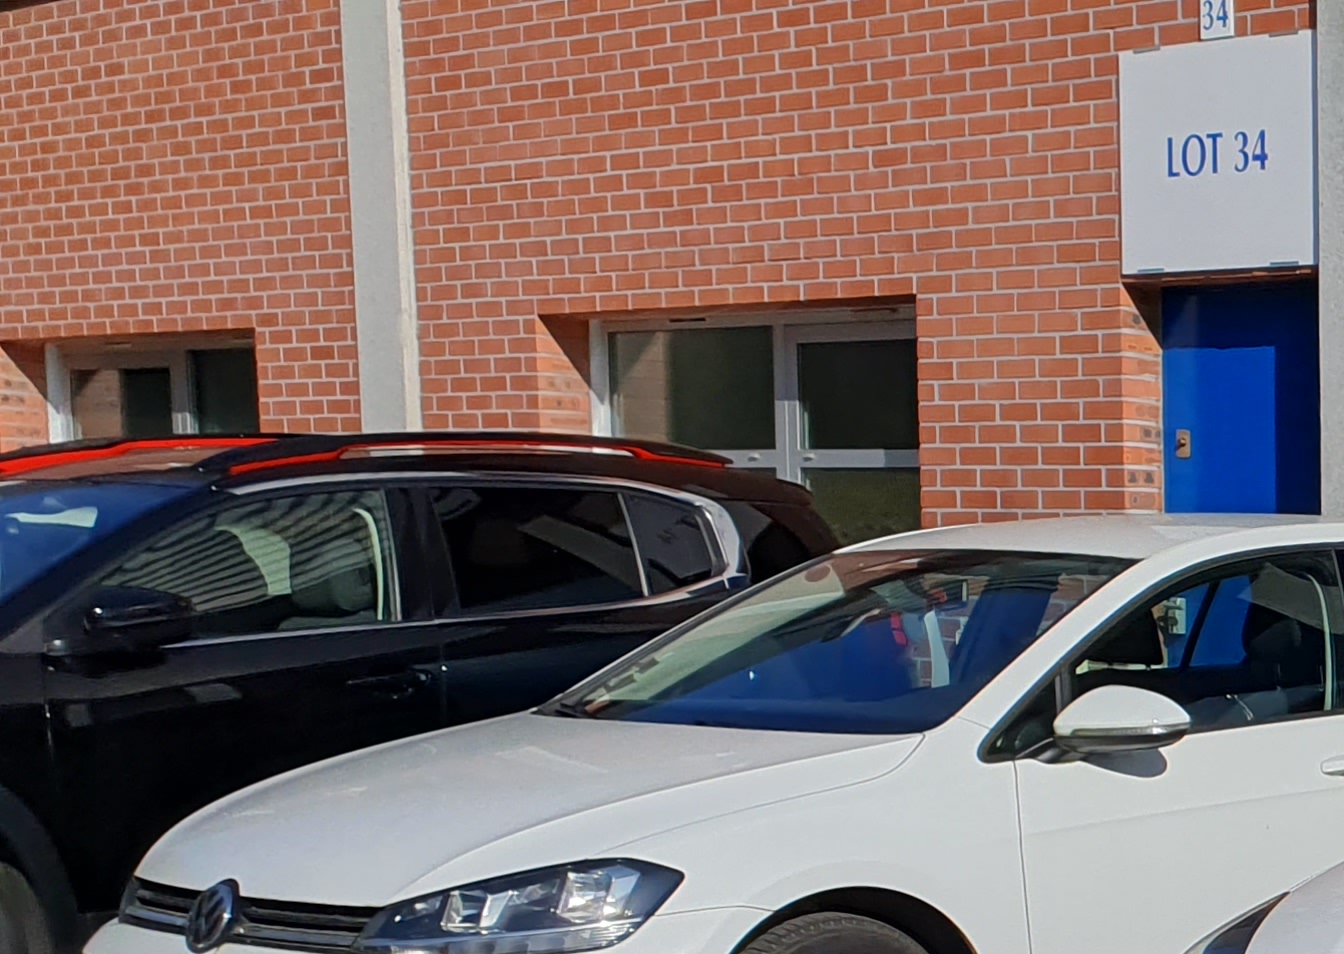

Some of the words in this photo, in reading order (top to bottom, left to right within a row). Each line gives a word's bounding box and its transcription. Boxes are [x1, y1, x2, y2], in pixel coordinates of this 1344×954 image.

[1202, 0, 1229, 31] 34
[1167, 132, 1223, 178] LOT
[1234, 129, 1269, 173] 34
